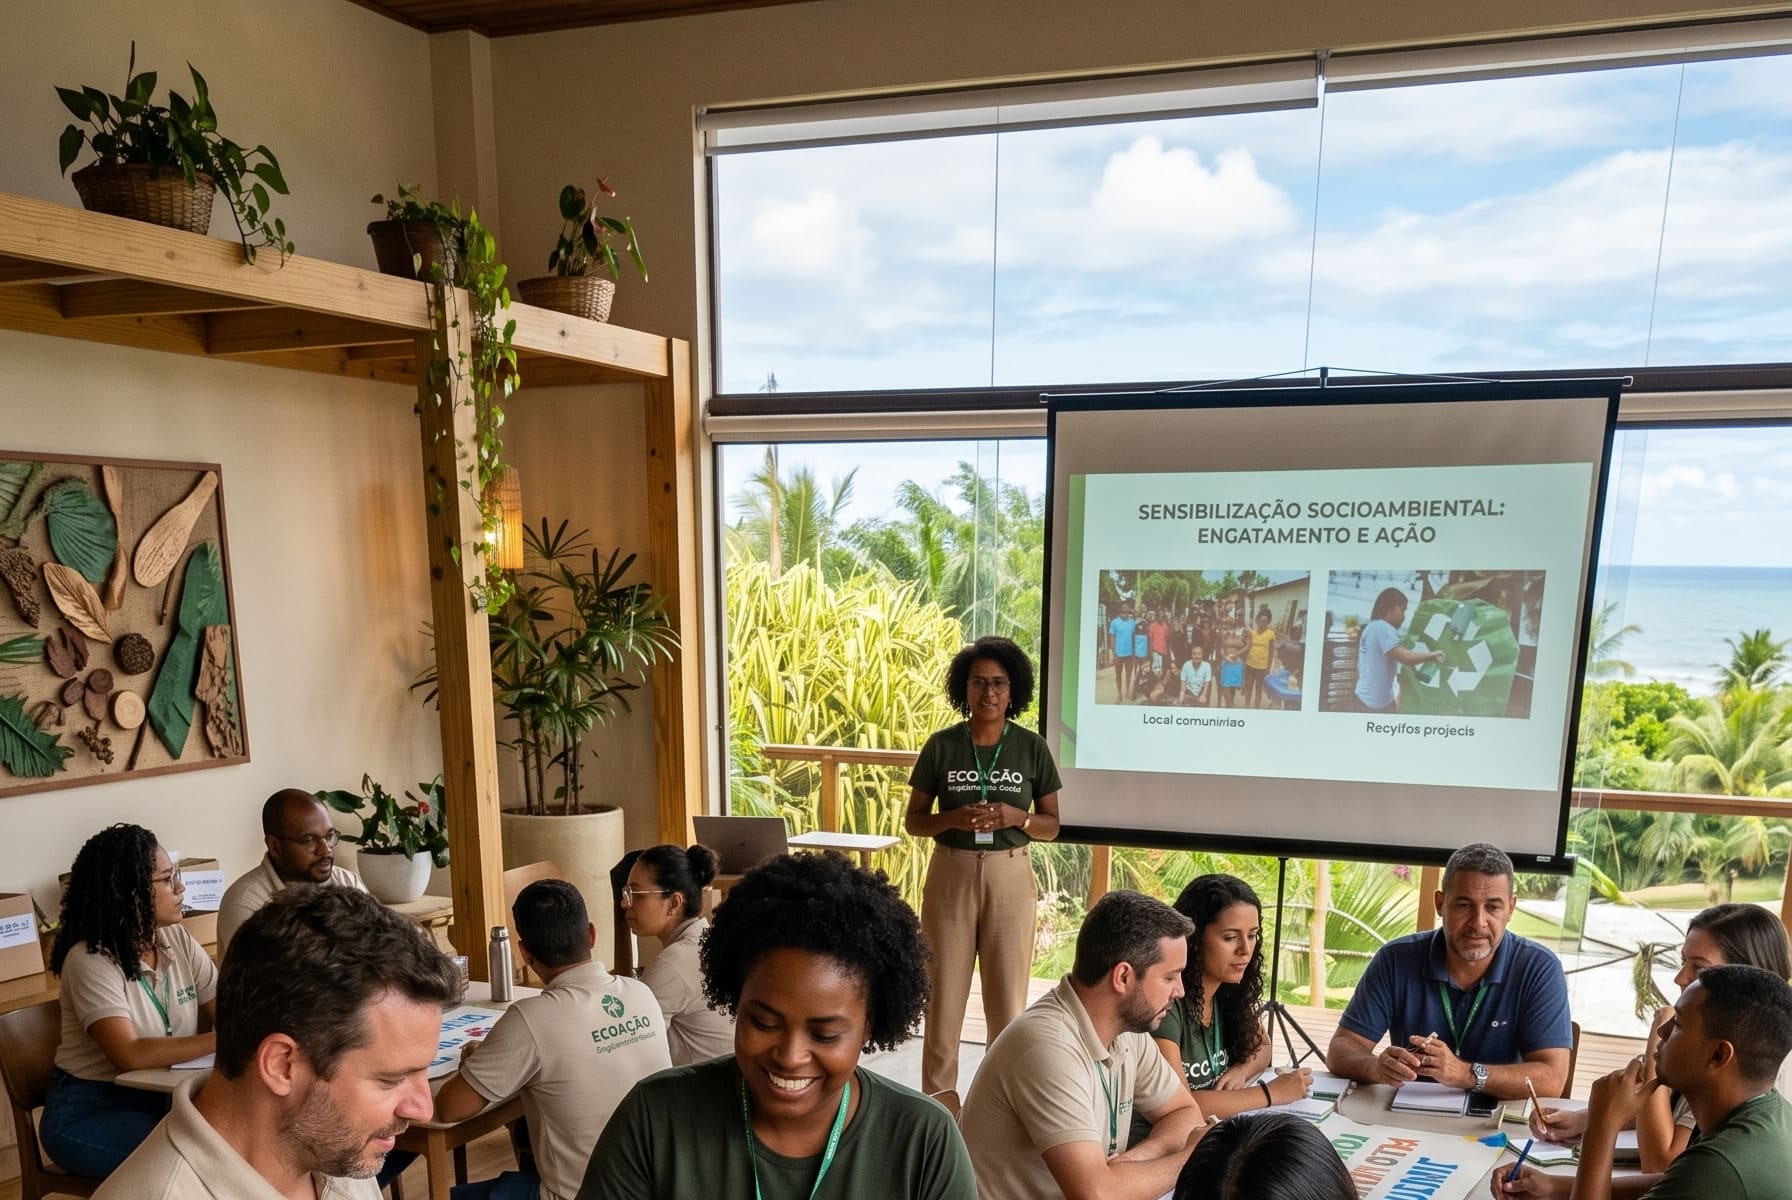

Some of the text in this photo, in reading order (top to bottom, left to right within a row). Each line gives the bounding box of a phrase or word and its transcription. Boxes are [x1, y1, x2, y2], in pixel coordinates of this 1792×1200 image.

[1138, 499, 1505, 523] SENSIBILIZAÇÃO SOCIOAMBIENTAL:
[1197, 523, 1436, 547] ENGATAMENTO E AÇÃO
[1143, 713, 1173, 725] Local
[947, 769, 1023, 784] ECOÇÃO
[591, 1015, 651, 1043] ECOAÇÃO
